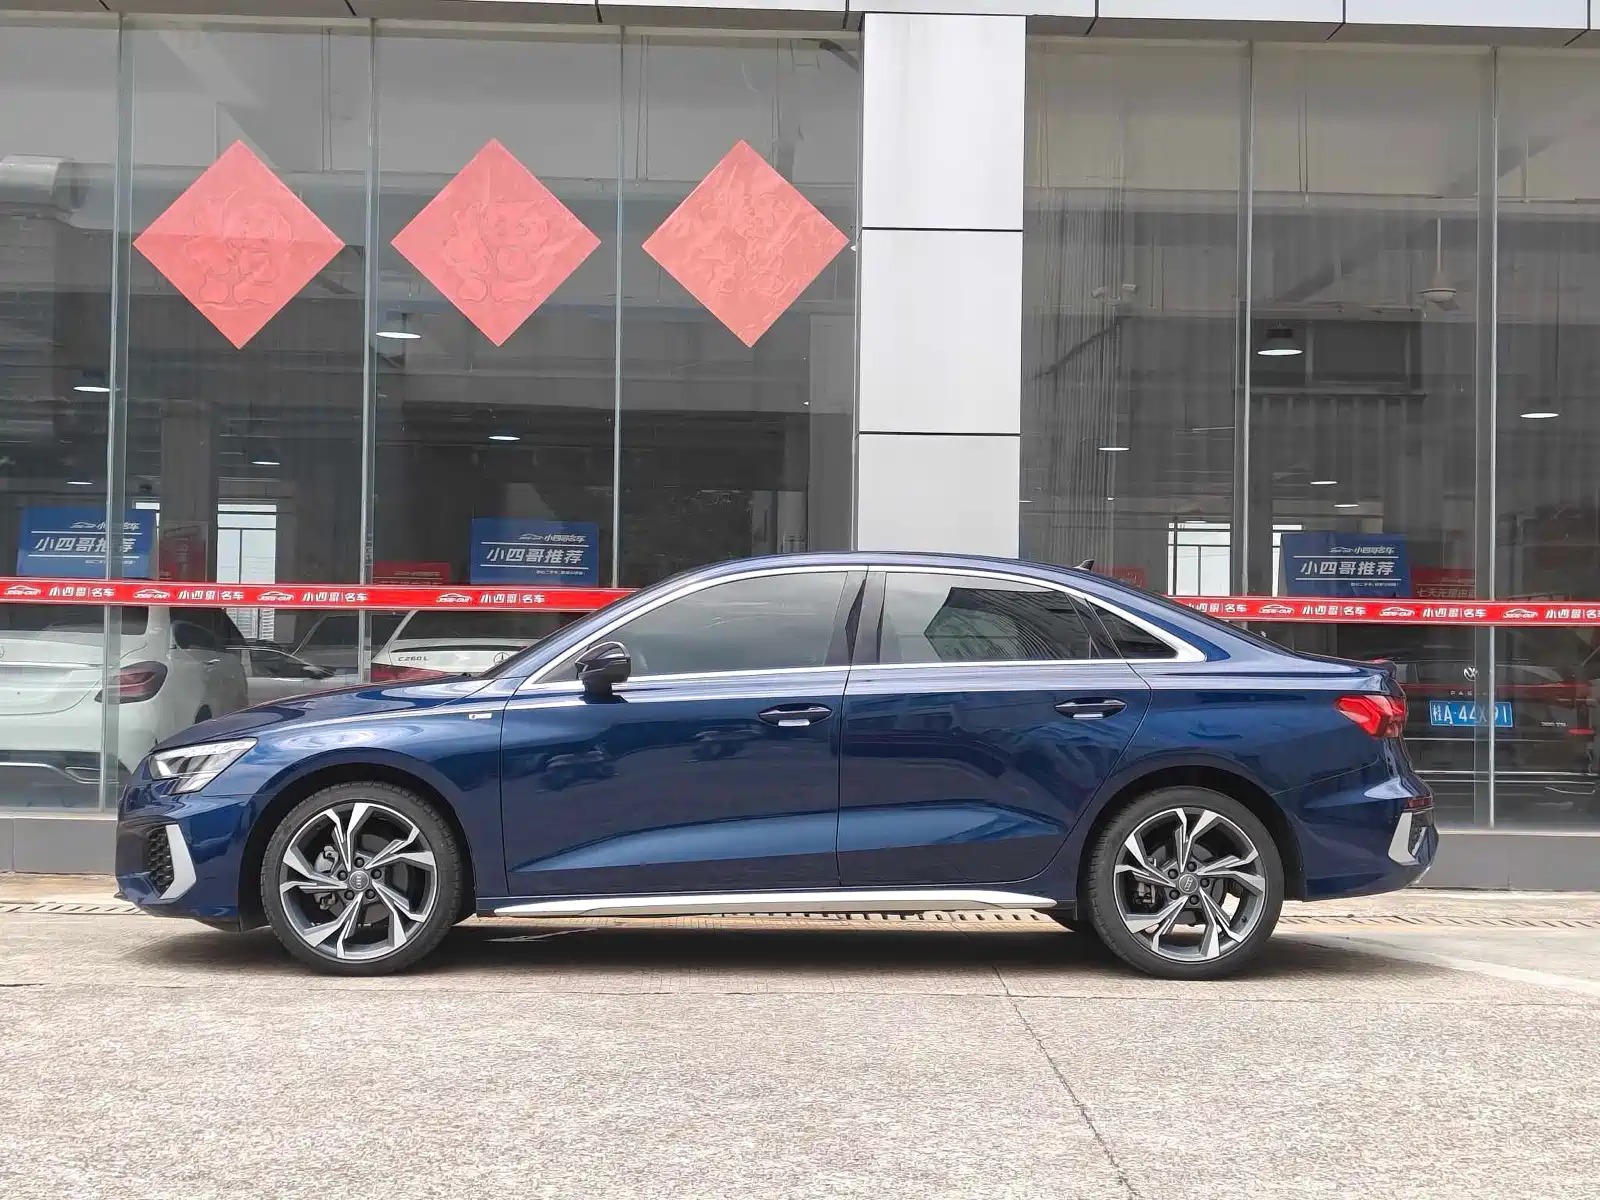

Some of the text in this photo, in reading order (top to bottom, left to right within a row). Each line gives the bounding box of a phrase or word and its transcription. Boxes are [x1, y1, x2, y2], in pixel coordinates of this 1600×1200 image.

[486, 548, 583, 563] 小四哥推荐
[1300, 561, 1395, 575] 小四哥推荐
